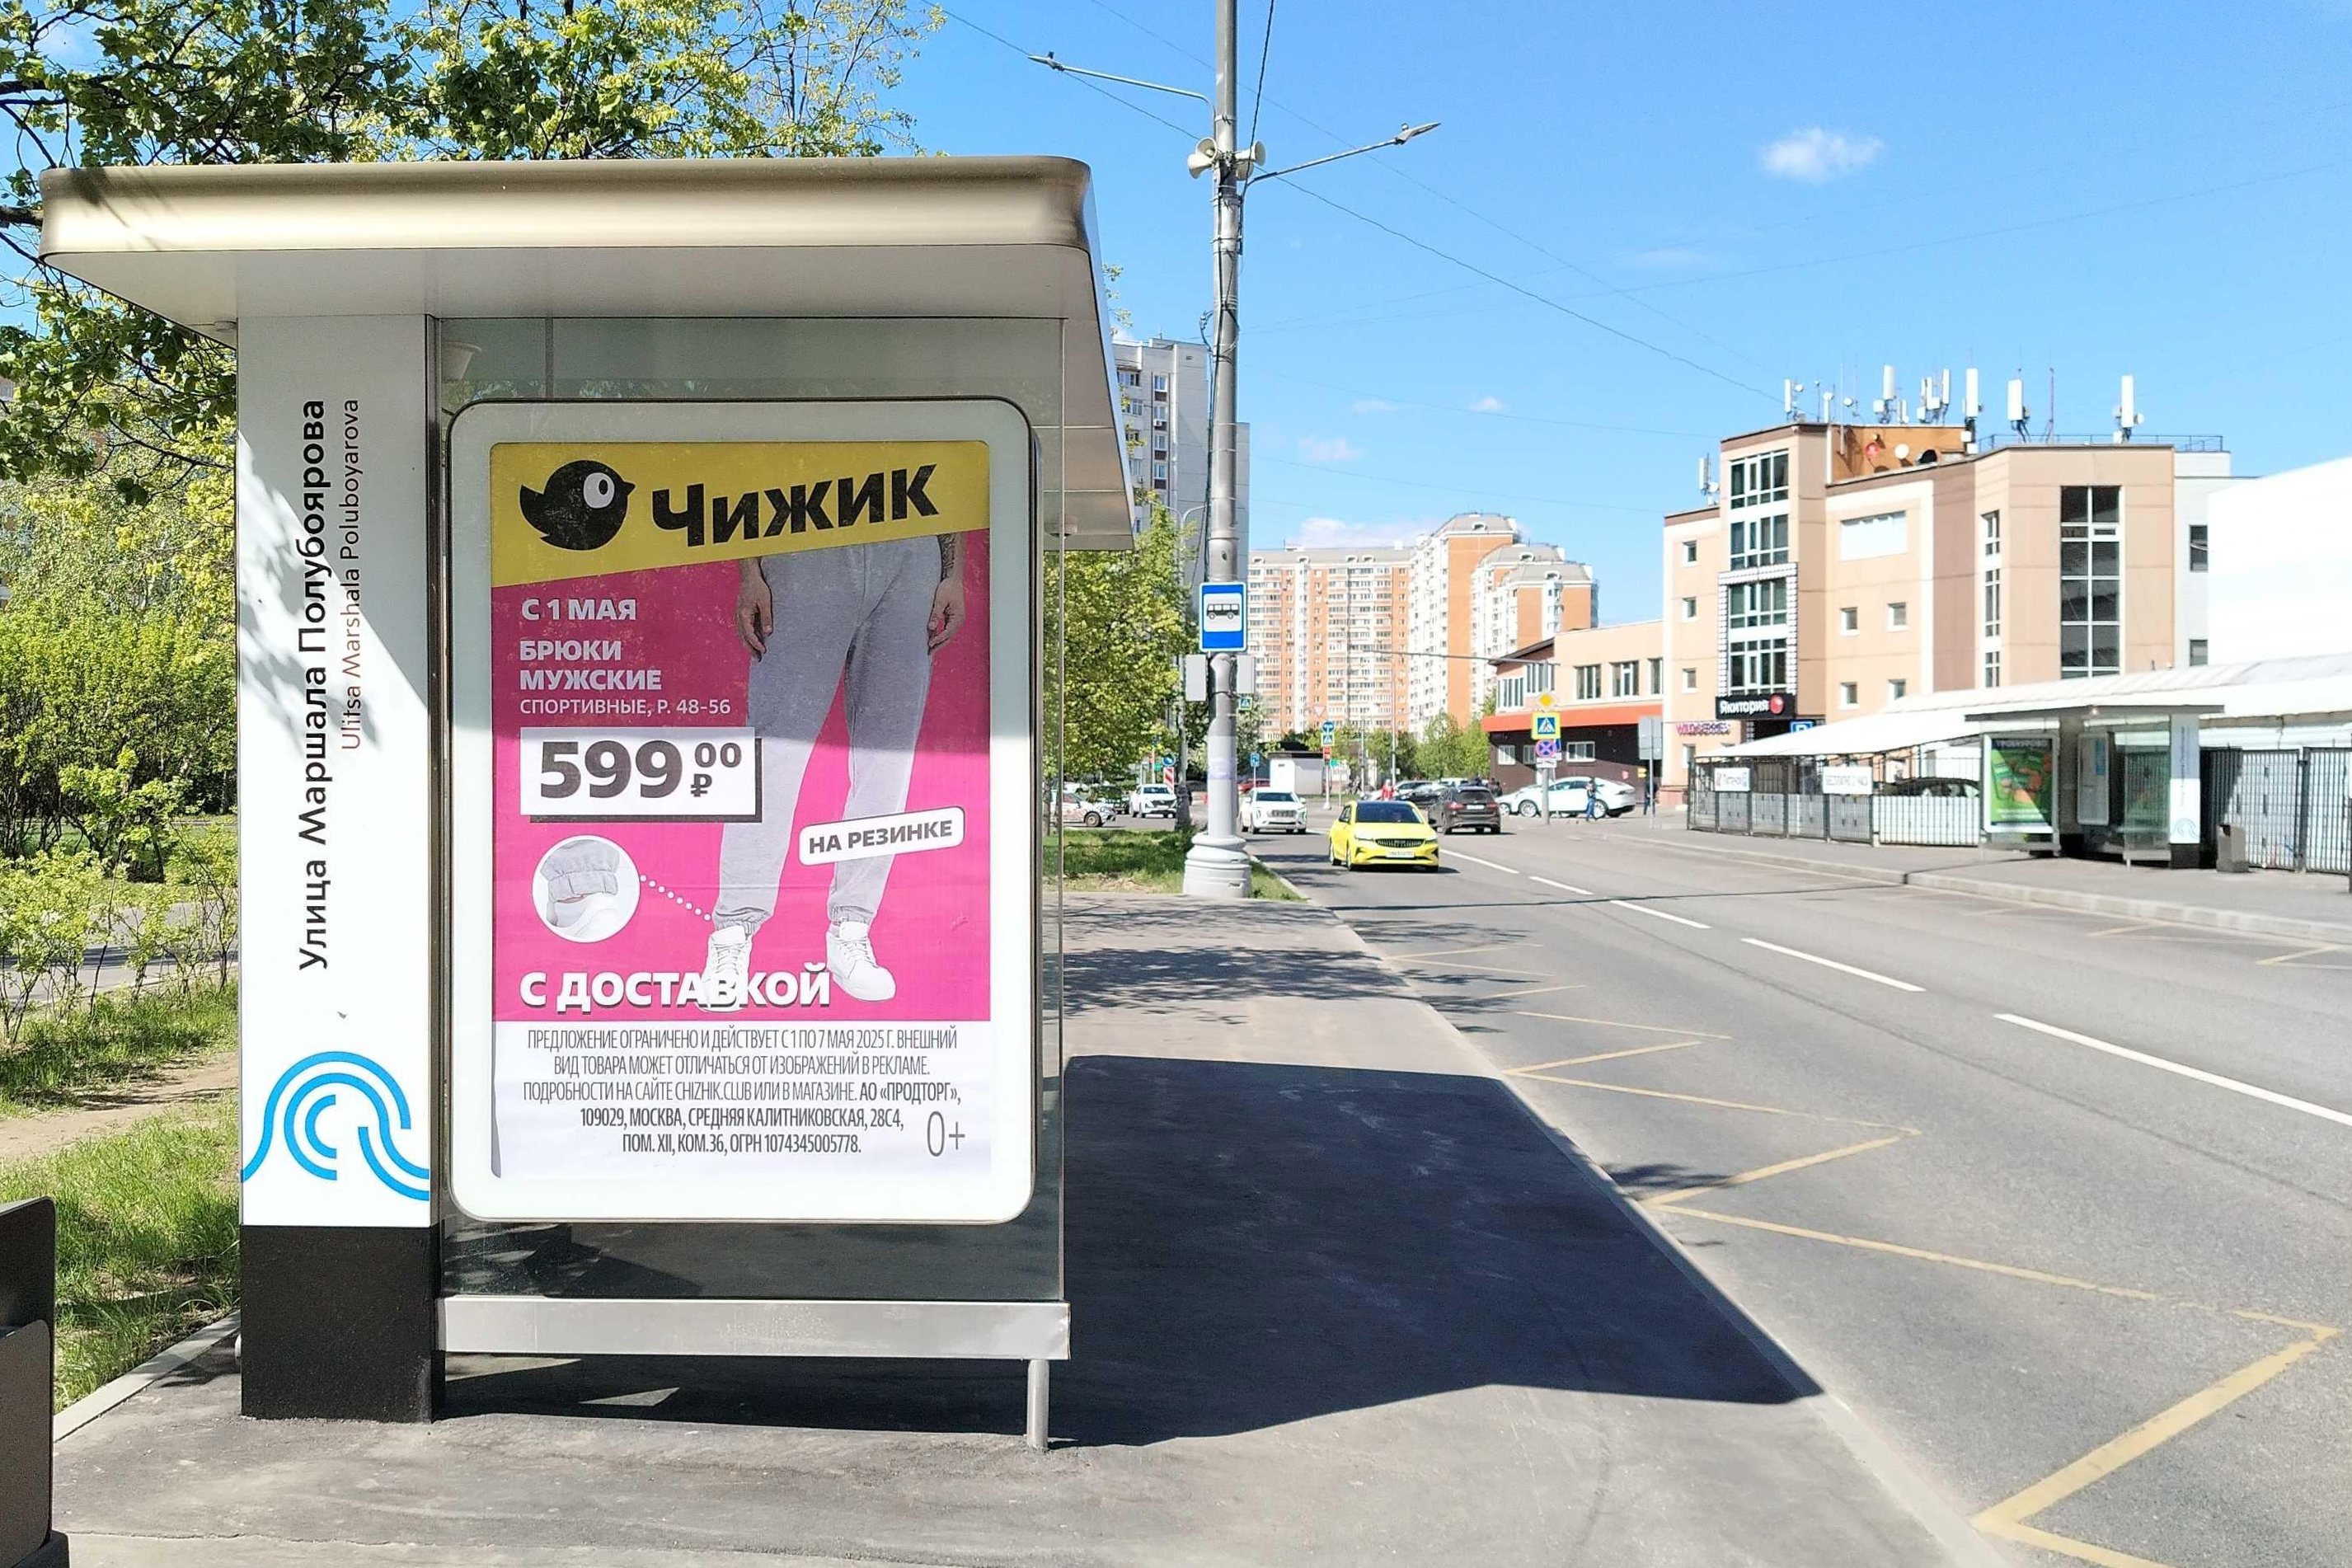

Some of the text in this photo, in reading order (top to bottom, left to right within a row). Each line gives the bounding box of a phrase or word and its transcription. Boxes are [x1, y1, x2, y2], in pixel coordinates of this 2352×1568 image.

[339, 399, 363, 749] Ulitsa Marshala Poluboyarova
[521, 599, 636, 620] С 1 МАЯ
[519, 640, 622, 661] БРЮКИ
[296, 401, 332, 969] Улица Маршала Полубоярова
[519, 669, 662, 691] МУЖСКИЕ
[519, 699, 731, 717] СПОРТИВНЫЕ, Р. 48-56
[1720, 700, 1770, 715] Якитория
[540, 739, 683, 799] 599
[694, 742, 742, 768] 00
[809, 820, 953, 854] НА РЕЗИНКЕ
[519, 962, 831, 1015] С ДОСТАВКОЙ
[528, 1025, 957, 1053] ПРЕДЛОЖЕНИЕ ОГРАНИЧЕНО И ДЕЙСТВУЕТ С 1 ПО 7 МАЯ 2025 Г. ВНЕШНИЙ
[554, 1051, 930, 1078] ВИД ТОВАРА МОЖЕТ ОТЛИЧАТЬСЯ ОТ ИЗОБРАЖЕНИЙ В РЕКЛАМЕ.
[523, 1077, 961, 1105] ПОДРОБНОСТИ НА САЙТЕ CHIZHIK.CLUB ИЛИ В МАГАЗИНЕ. АО «ПРОДТОРГ»,
[580, 1107, 627, 1129] 109029,
[629, 1107, 686, 1129] МОСКВА,
[688, 1107, 744, 1129] СРЕДНЯЯ
[747, 1107, 868, 1130] КАЛИТНИКОВСКАЯ,
[622, 1133, 861, 1156] ПОМ. XII, КОМ.36, ОГРН 1074345005778.
[927, 1110, 965, 1157] 0+
